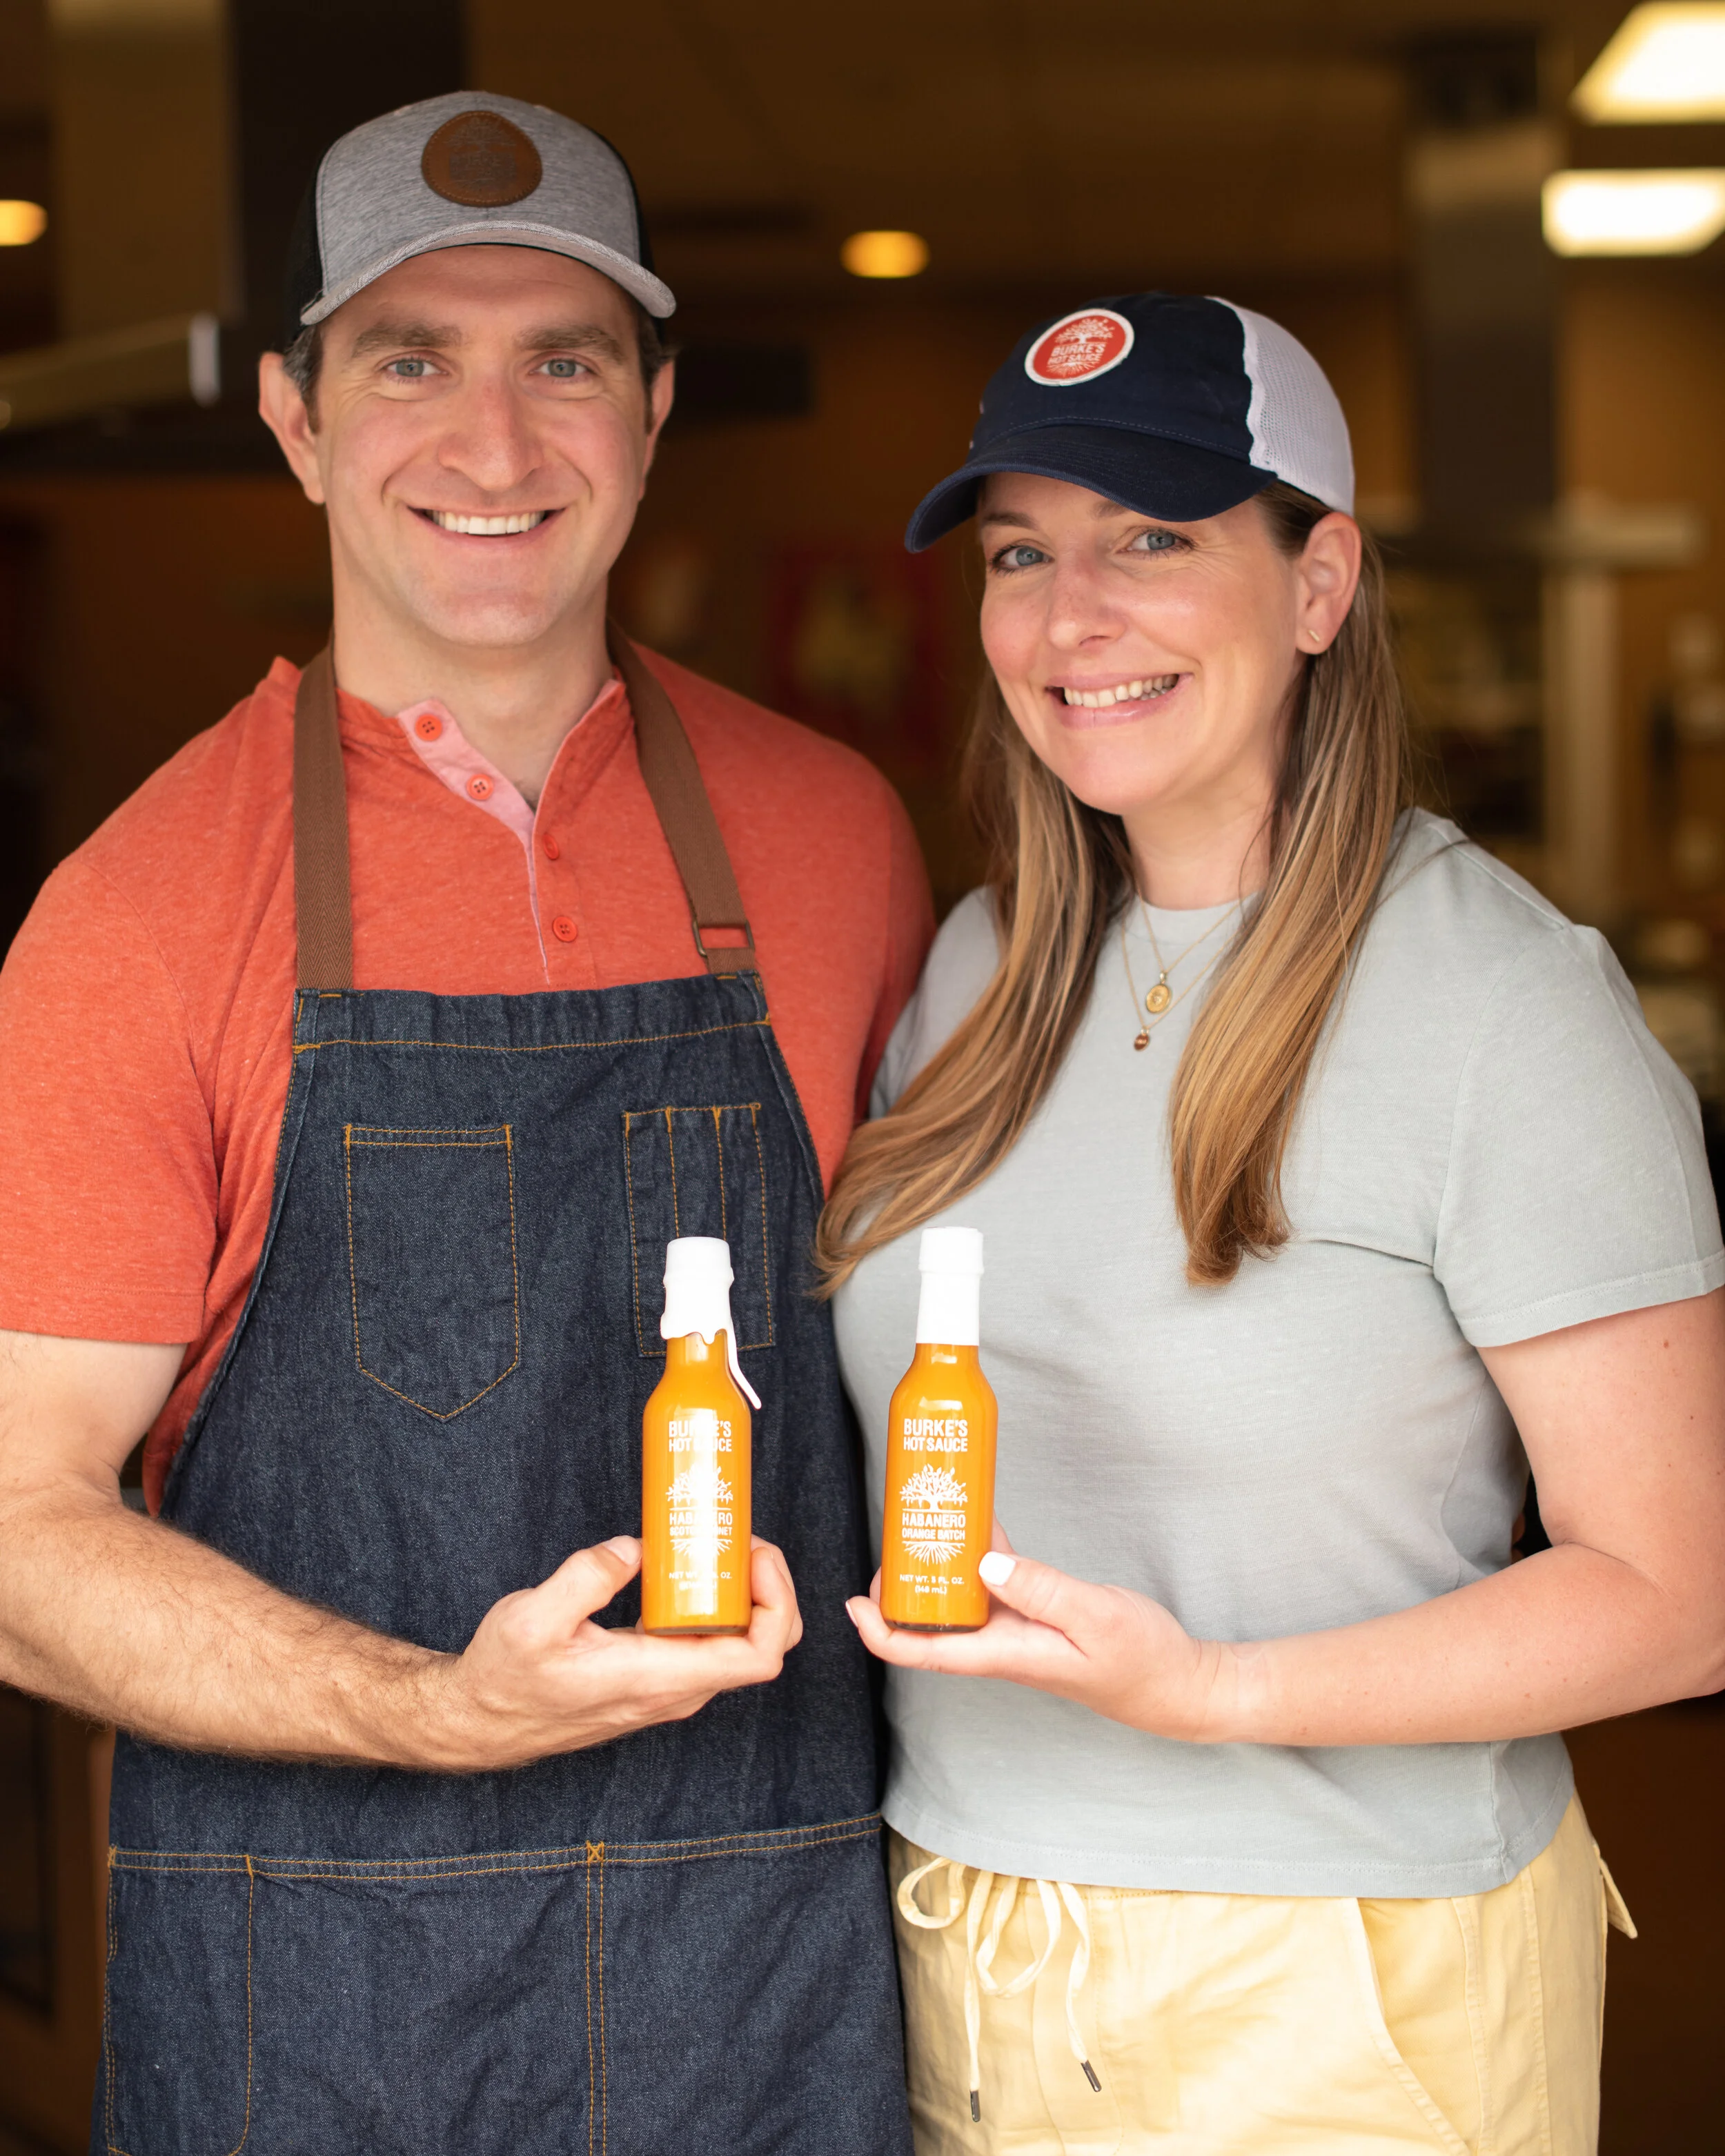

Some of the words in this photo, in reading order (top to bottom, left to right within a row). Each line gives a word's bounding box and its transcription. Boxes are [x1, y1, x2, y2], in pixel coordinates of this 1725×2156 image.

[1051, 343, 1106, 357] BURKE'S
[1067, 353, 1103, 362] SAUCE
[904, 1418, 968, 1437] BURKE'S
[669, 1437, 692, 1452] HOT
[903, 1436, 925, 1451] HOT
[926, 1437, 968, 1452] SAUCE
[902, 1512, 966, 1528] HABANERO
[902, 1527, 936, 1540] ORANGE
[937, 1528, 965, 1541] BATCH
[899, 1574, 914, 1582] NET
[915, 1575, 929, 1583] WT.
[938, 1576, 949, 1584] FL.
[951, 1576, 965, 1585] OZ.
